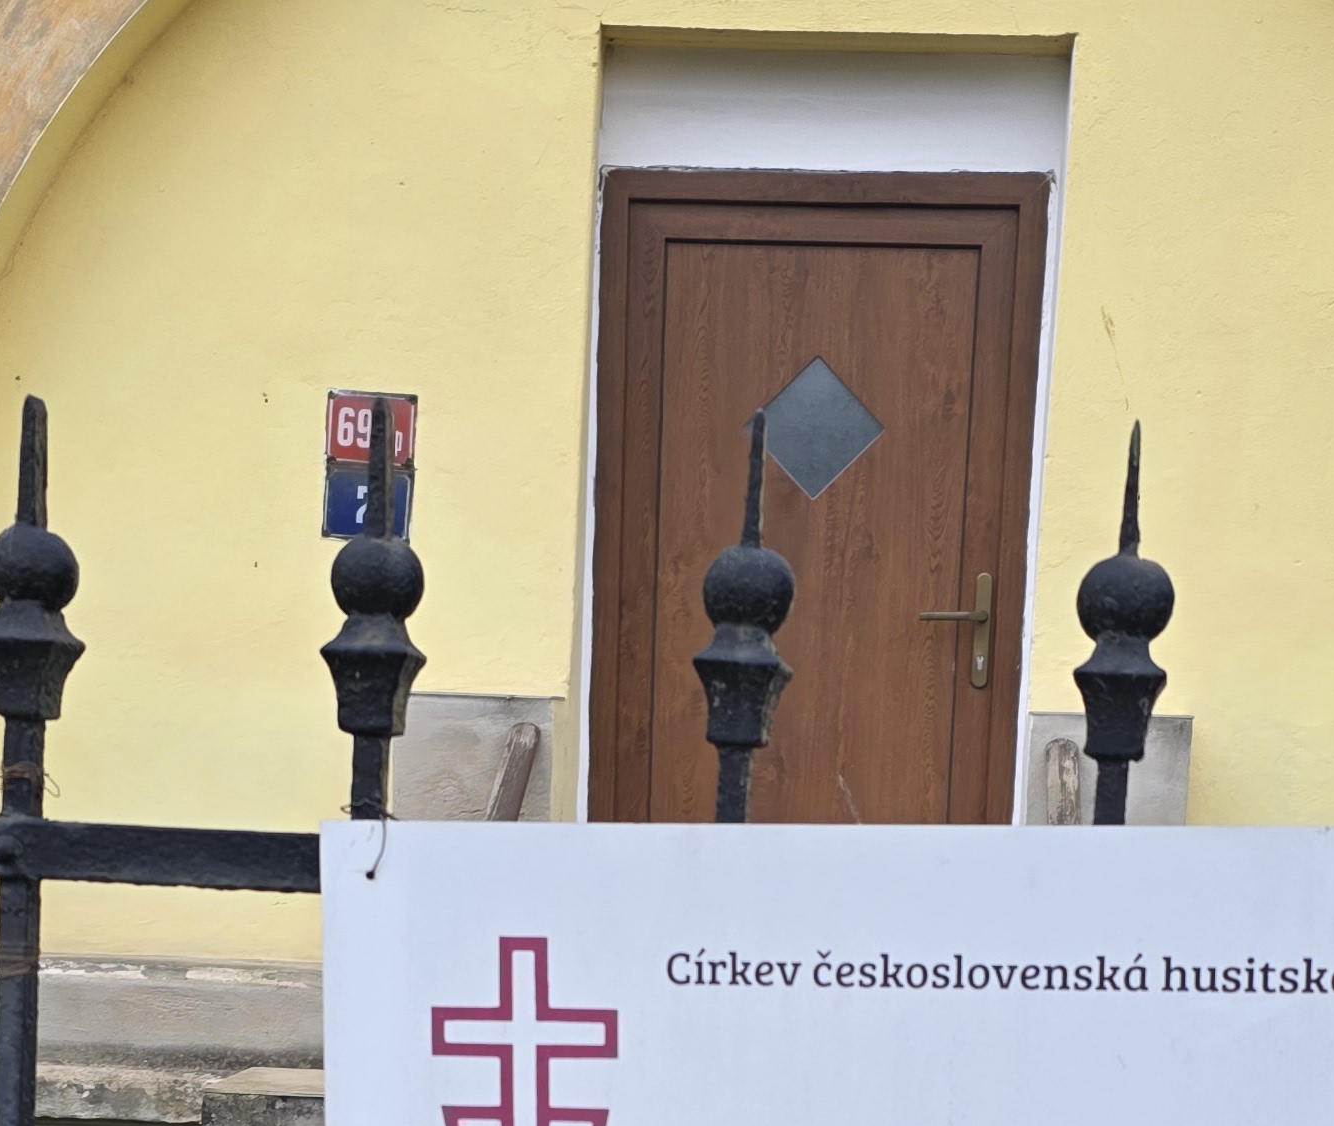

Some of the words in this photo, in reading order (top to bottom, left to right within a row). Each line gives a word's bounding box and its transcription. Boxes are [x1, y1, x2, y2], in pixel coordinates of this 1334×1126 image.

[336, 406, 394, 450] 69
[666, 947, 802, 987] Církev
[812, 950, 1150, 993] československá
